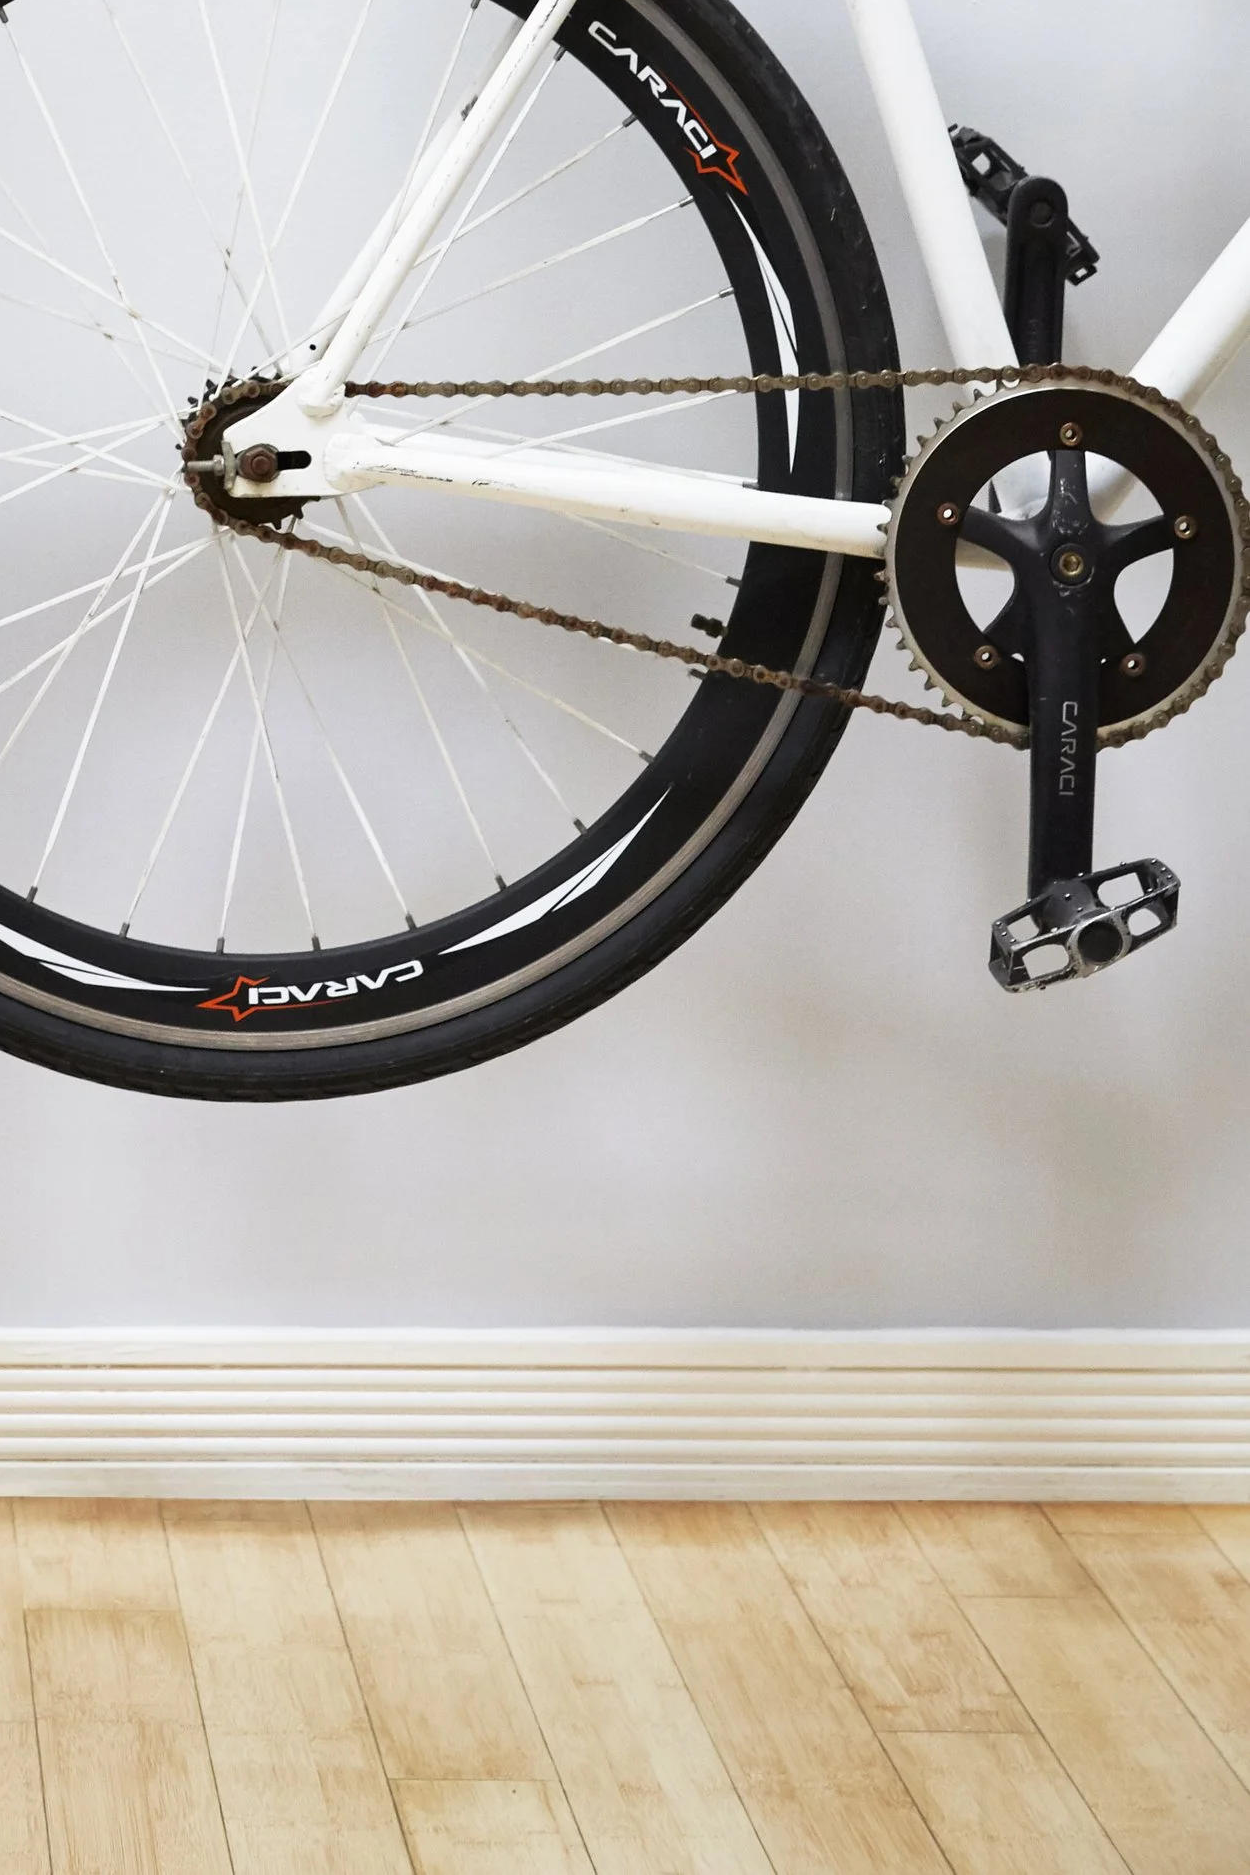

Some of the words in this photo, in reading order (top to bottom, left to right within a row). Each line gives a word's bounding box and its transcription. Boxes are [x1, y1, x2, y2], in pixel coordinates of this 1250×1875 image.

[587, 20, 718, 160] CARACI
[1058, 700, 1078, 797] CARACI
[248, 959, 425, 1006] CARACI
